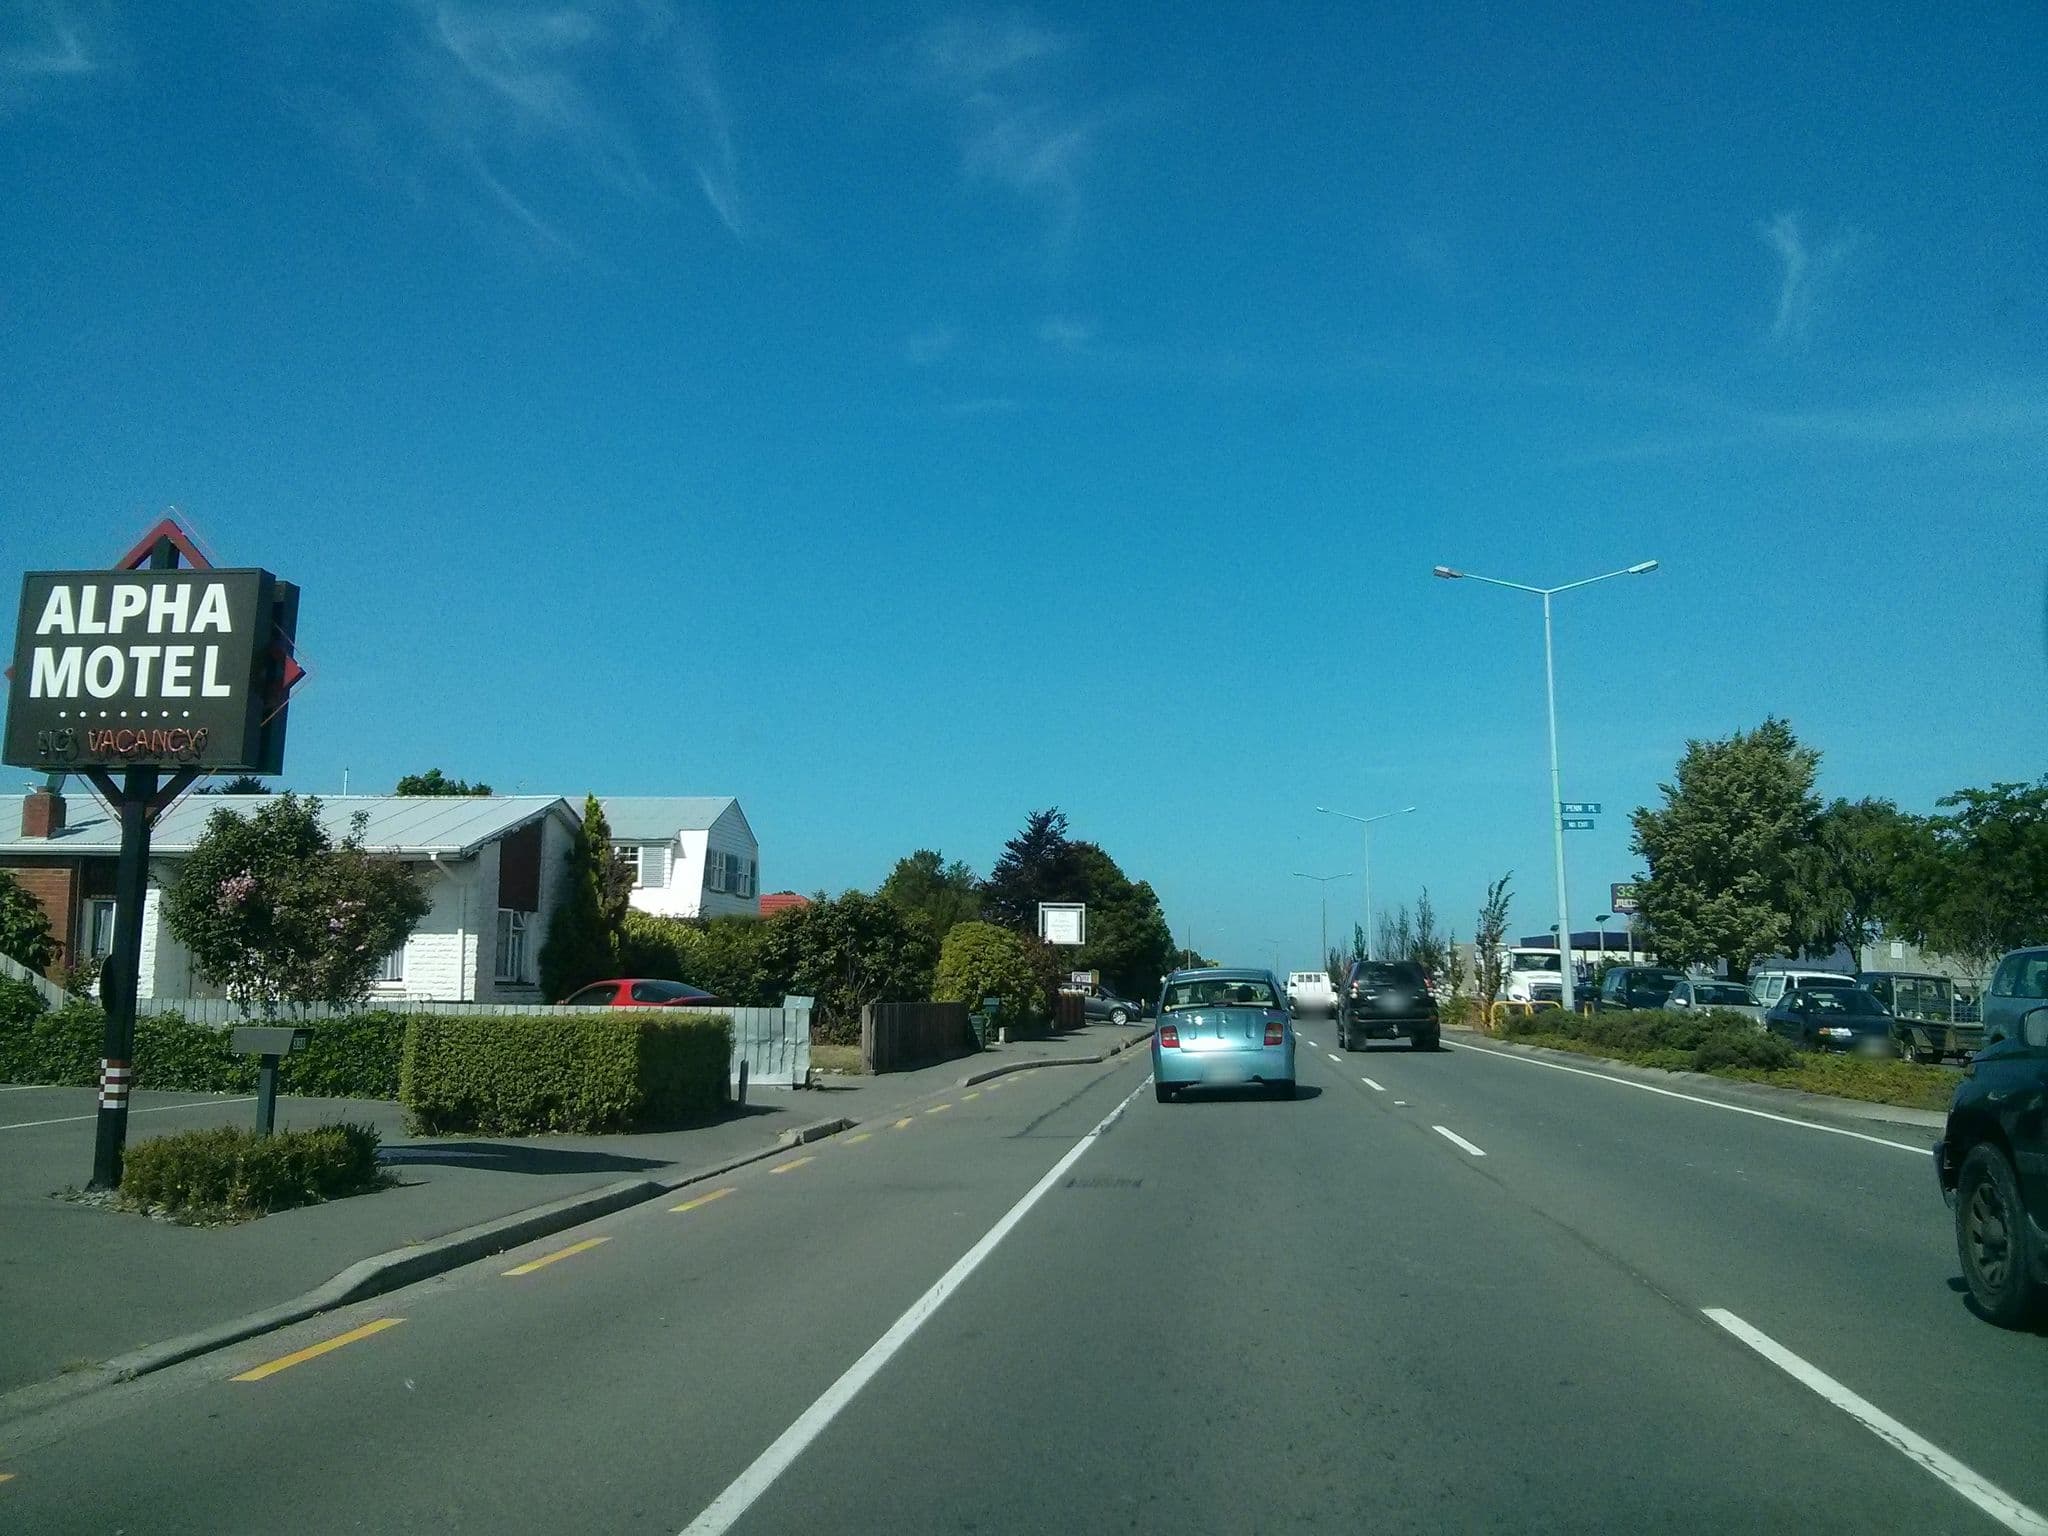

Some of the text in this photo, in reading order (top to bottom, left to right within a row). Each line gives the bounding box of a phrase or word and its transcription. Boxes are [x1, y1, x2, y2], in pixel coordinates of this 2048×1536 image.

[36, 583, 232, 635] ALPHA
[29, 645, 231, 698] MOTEL
[88, 728, 208, 753] VACANCY
